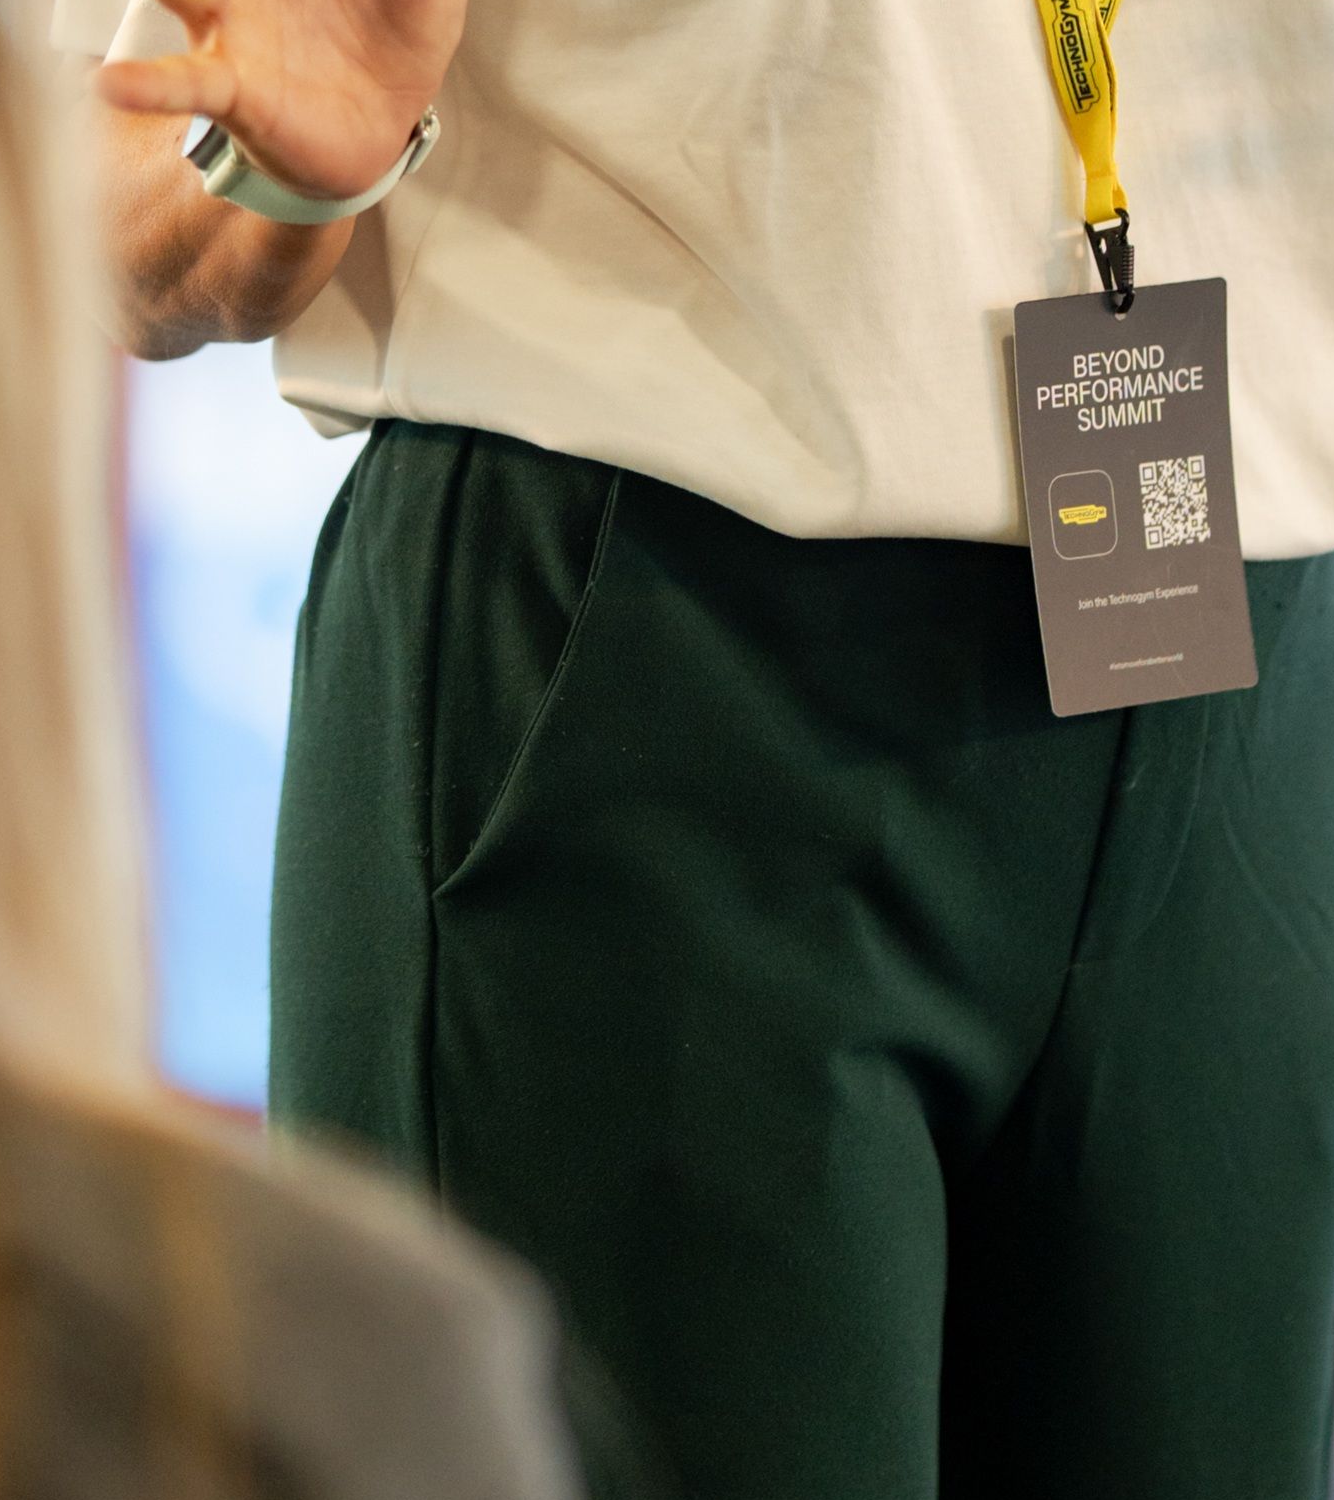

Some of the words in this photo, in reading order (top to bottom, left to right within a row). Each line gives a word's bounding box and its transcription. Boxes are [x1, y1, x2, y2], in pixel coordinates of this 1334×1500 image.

[1073, 345, 1165, 379] BEYOND
[1036, 366, 1204, 411] PERFORMANCE
[1077, 398, 1166, 432] SUMMIT
[1078, 599, 1094, 610] Join
[1095, 597, 1108, 607] the
[1108, 590, 1155, 604] Technogym
[1155, 584, 1198, 599] Experience
